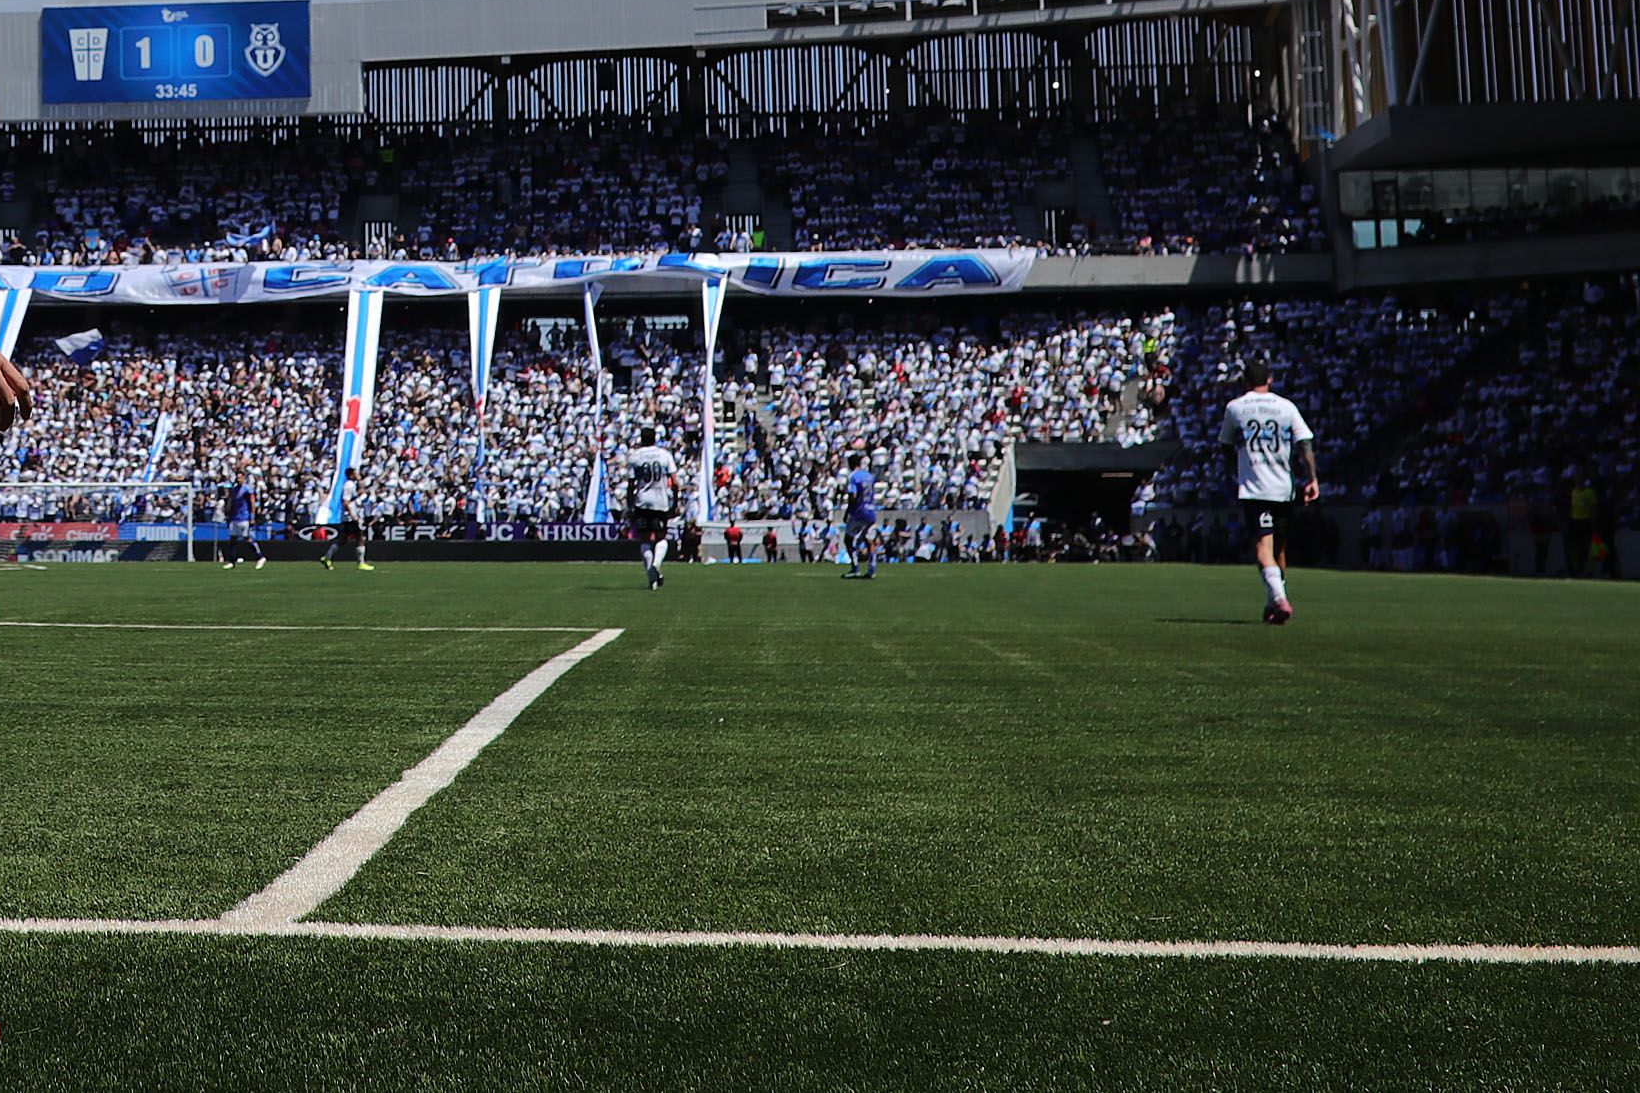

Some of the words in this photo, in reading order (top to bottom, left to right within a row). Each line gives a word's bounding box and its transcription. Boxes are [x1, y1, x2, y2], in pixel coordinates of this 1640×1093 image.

[135, 36, 151, 69] 1
[194, 34, 215, 68] 0
[155, 83, 198, 99] 33:45
[1247, 419, 1279, 453] 23
[66, 529, 104, 541] Claro
